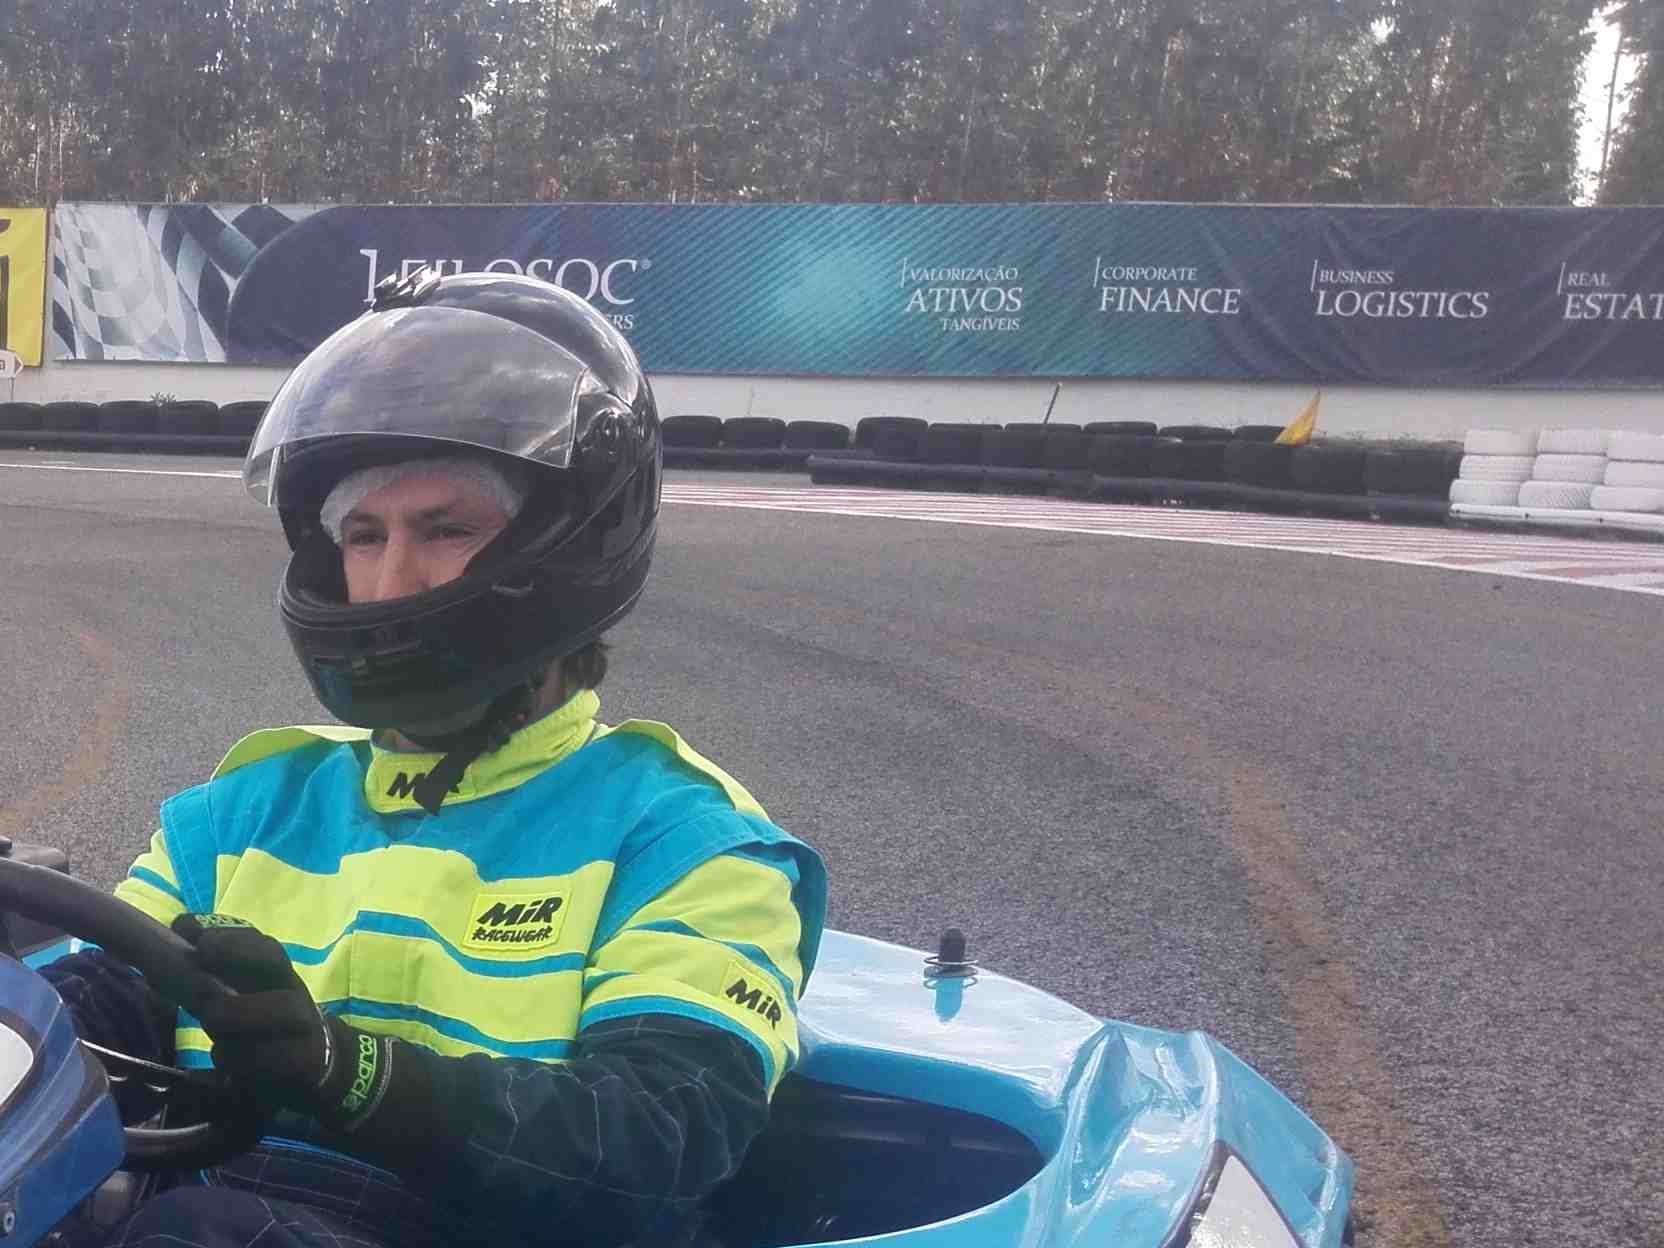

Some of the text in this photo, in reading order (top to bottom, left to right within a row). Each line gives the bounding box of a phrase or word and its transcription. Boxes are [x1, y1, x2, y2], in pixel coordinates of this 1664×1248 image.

[910, 265, 1019, 282] VALORIZAÇÃO
[1102, 266, 1197, 282] CORPORATE
[1319, 269, 1394, 284] BUSINESS
[1567, 272, 1610, 287] REAL
[904, 286, 1024, 313] ATIVOS
[1099, 287, 1241, 315] FINANCE
[1315, 289, 1489, 319] LOGISTICS
[941, 316, 1021, 332] TANGÍVEIS
